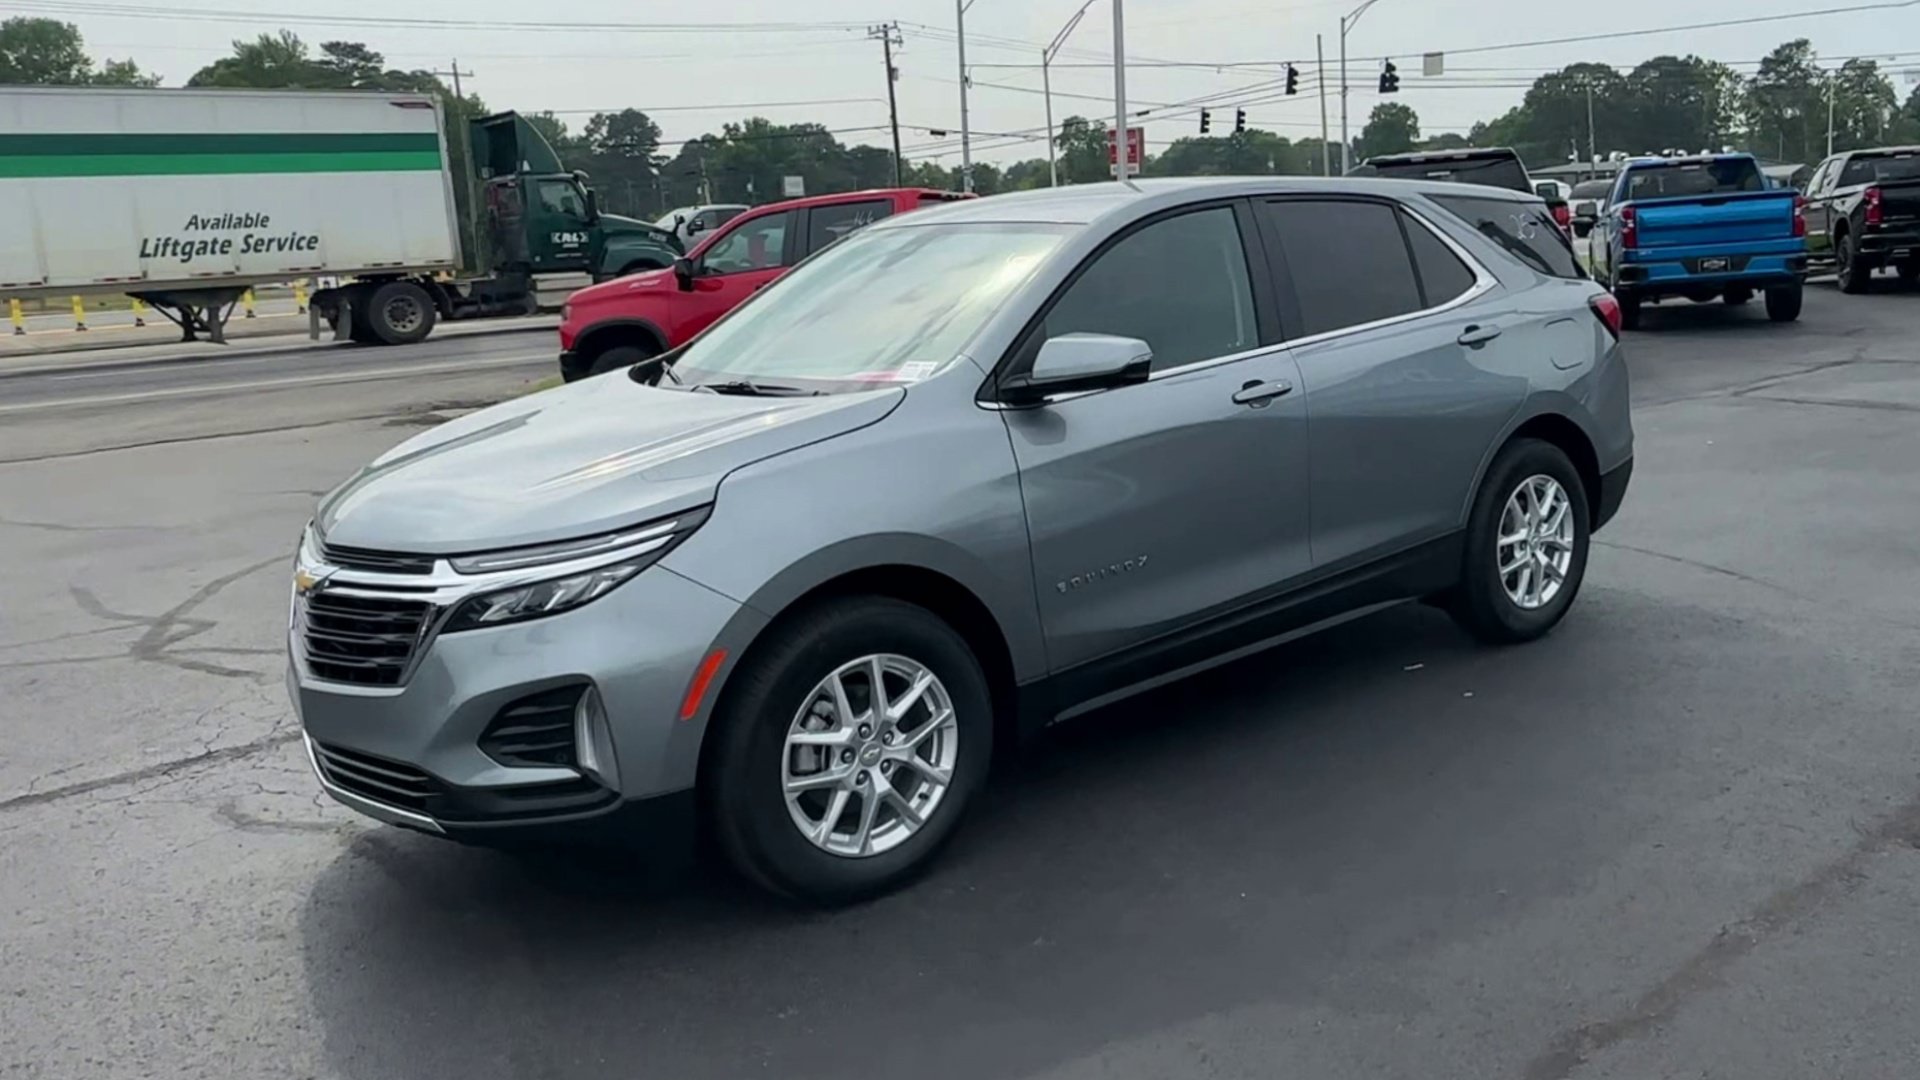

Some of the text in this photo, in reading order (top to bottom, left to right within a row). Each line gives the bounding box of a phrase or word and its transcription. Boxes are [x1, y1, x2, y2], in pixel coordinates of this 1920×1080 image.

[184, 212, 270, 231] Available
[139, 231, 319, 263] Liftgate Service
